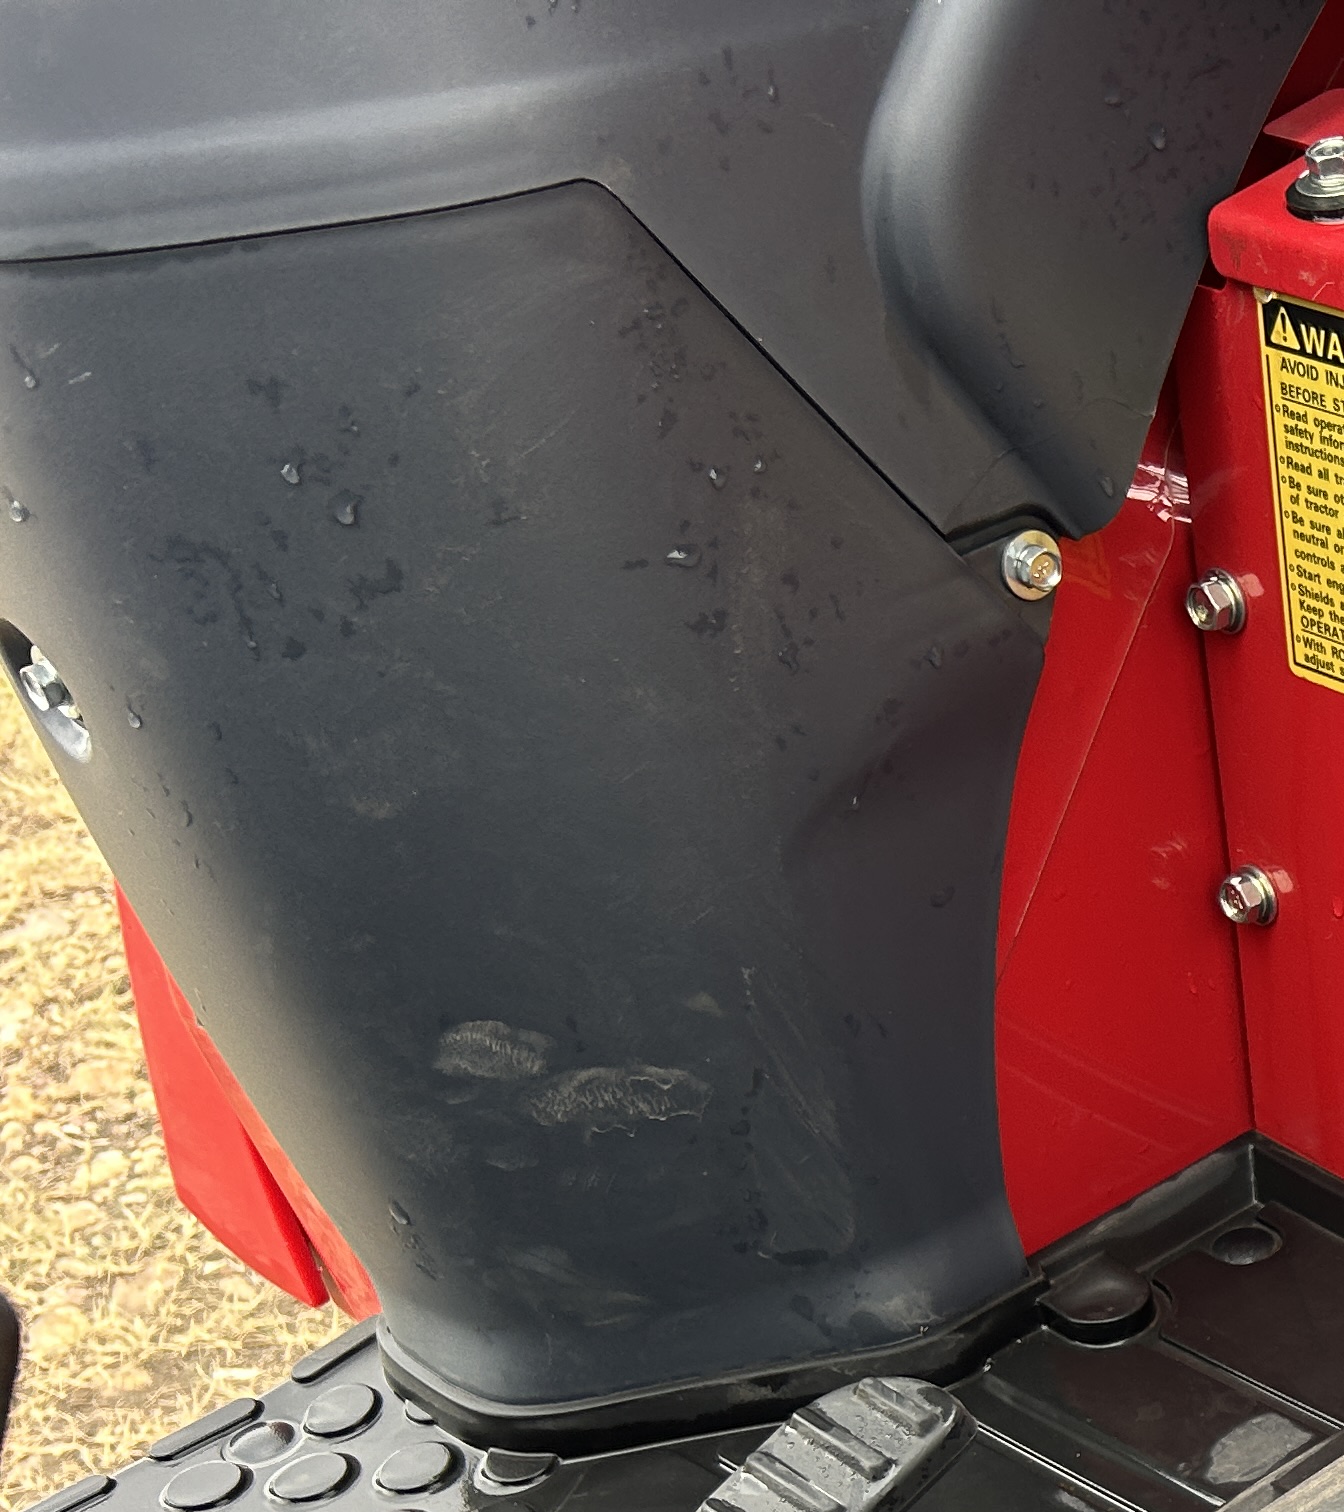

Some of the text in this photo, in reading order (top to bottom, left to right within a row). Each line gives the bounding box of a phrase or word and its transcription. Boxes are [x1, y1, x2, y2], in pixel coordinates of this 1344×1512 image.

[1279, 357, 1319, 381] AVOID
[1279, 382, 1327, 409] BEFORE
[1281, 405, 1308, 425] Read
[1285, 456, 1313, 476] Read
[1317, 467, 1329, 482] all
[1287, 475, 1301, 492] Be
[1306, 484, 1328, 500] sure
[1295, 564, 1322, 585] Start
[1297, 583, 1335, 608] Shields
[1298, 598, 1324, 620] Keep
[1301, 634, 1326, 655] With
[1303, 652, 1335, 675] adjust
